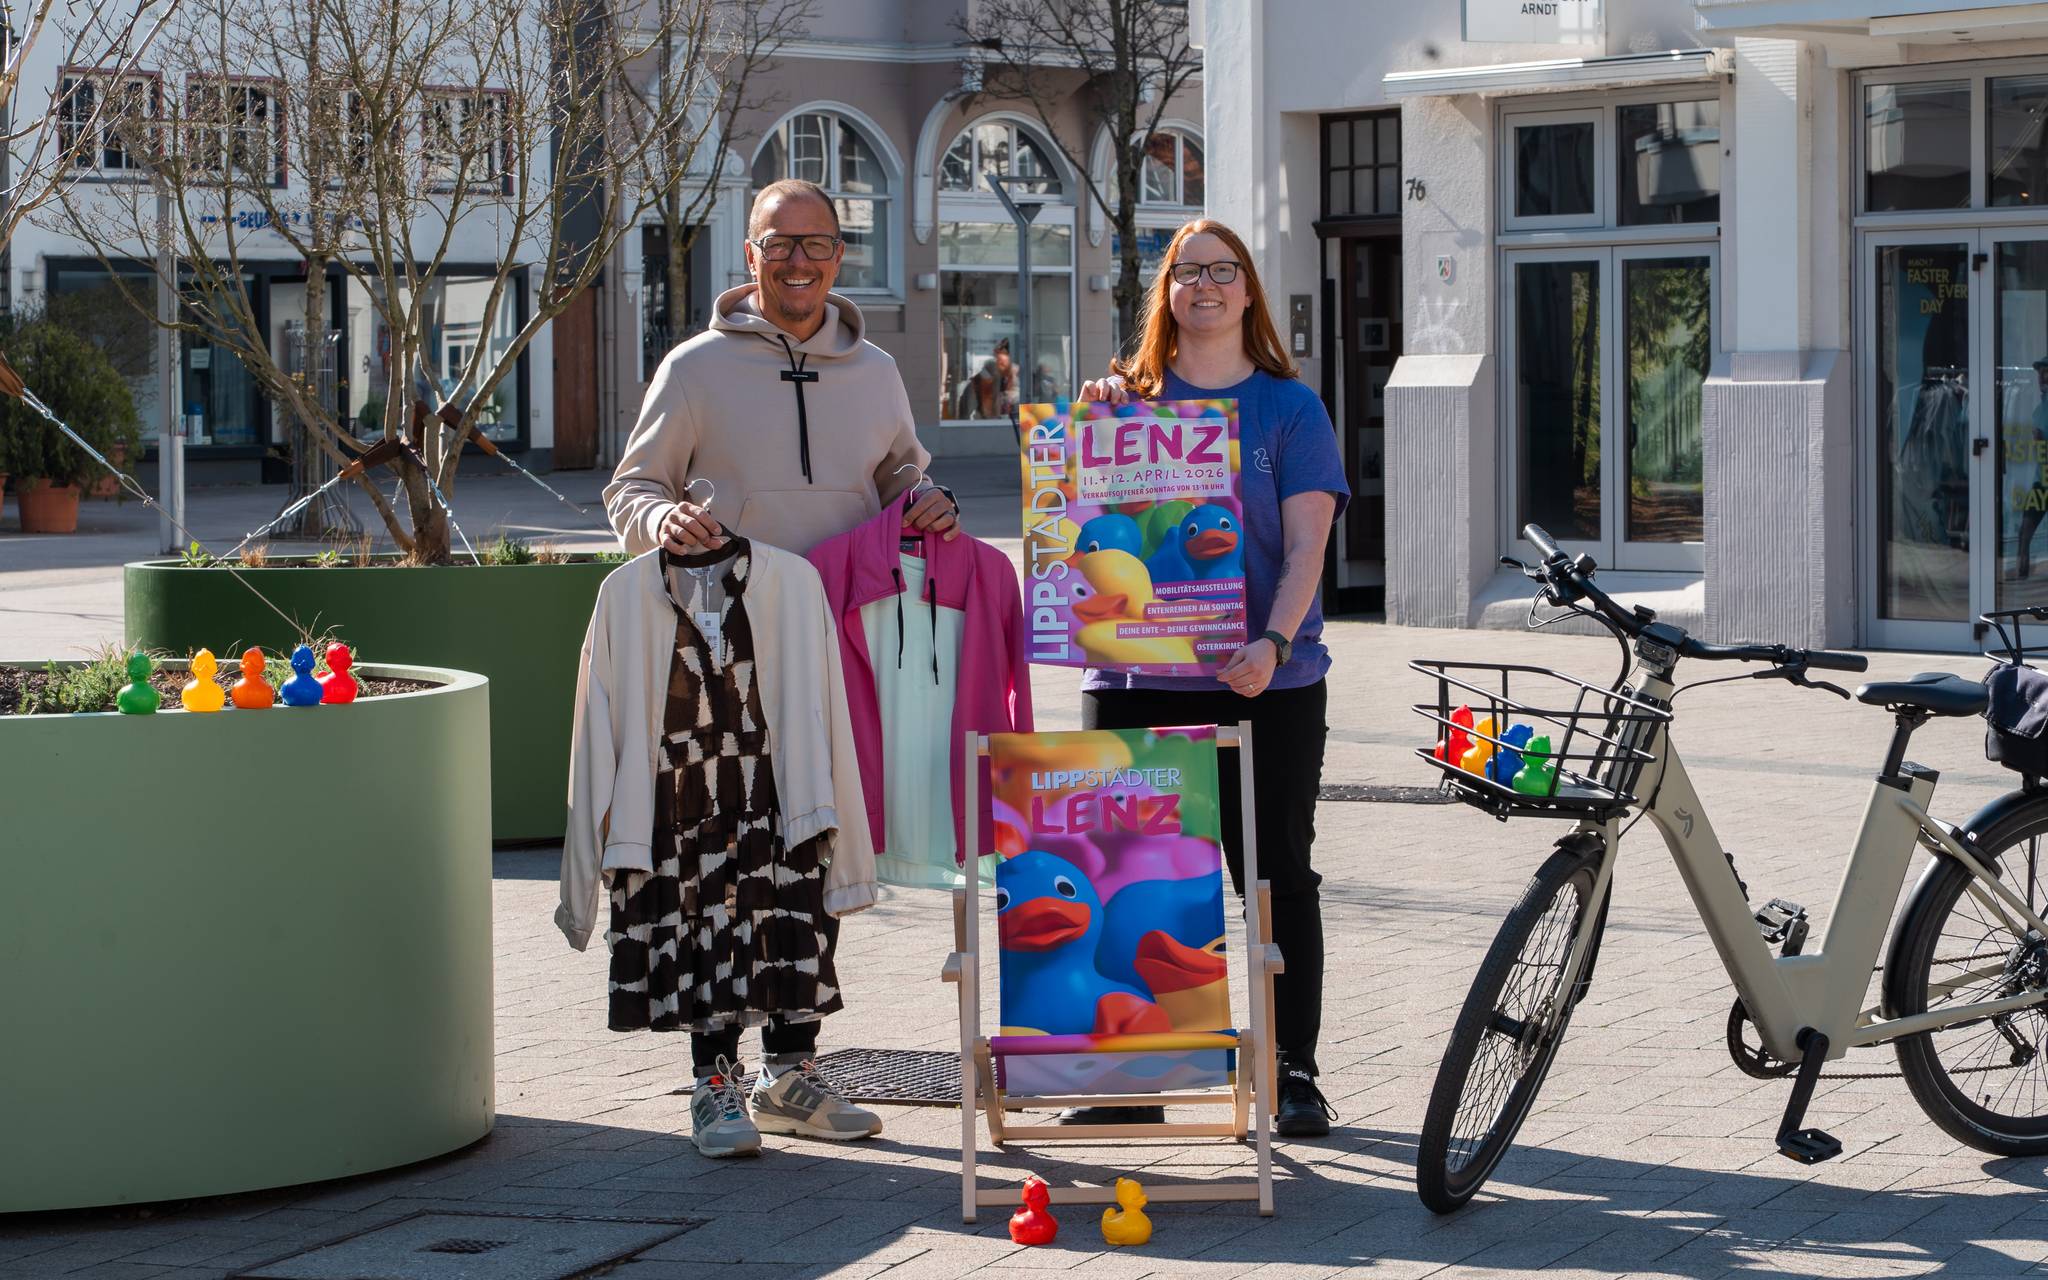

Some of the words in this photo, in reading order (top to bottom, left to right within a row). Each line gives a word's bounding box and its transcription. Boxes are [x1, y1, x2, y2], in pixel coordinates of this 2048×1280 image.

[1520, 3, 1558, 15] ARNDT
[1405, 177, 1426, 201] 76
[1908, 268, 1949, 283] FASTER
[1921, 299, 1944, 313] DAY
[1081, 422, 1224, 468] LENZ
[1133, 469, 1180, 482] APRIL
[1184, 467, 1224, 478] 2026
[1145, 485, 1175, 495] SONNTAG
[1177, 484, 1190, 492] VON
[1026, 422, 1069, 661] LIPPSTÄDTER
[1155, 582, 1243, 595] MOBILITÄTSAUSSTELLUNG
[1147, 604, 1197, 615] ENTENRENNEN
[1199, 604, 1210, 612] AM
[1211, 602, 1243, 612] SONNTAG
[1120, 626, 1140, 635] DEINE
[1141, 625, 1159, 634] ENTE
[1167, 624, 1188, 634] DEINE
[1189, 622, 1245, 632] GEWINNCHANCE
[1197, 641, 1246, 651] OSTERKIRMES
[1031, 766, 1182, 790] LIPPSTÄDTER
[1031, 792, 1182, 835] LENZ
